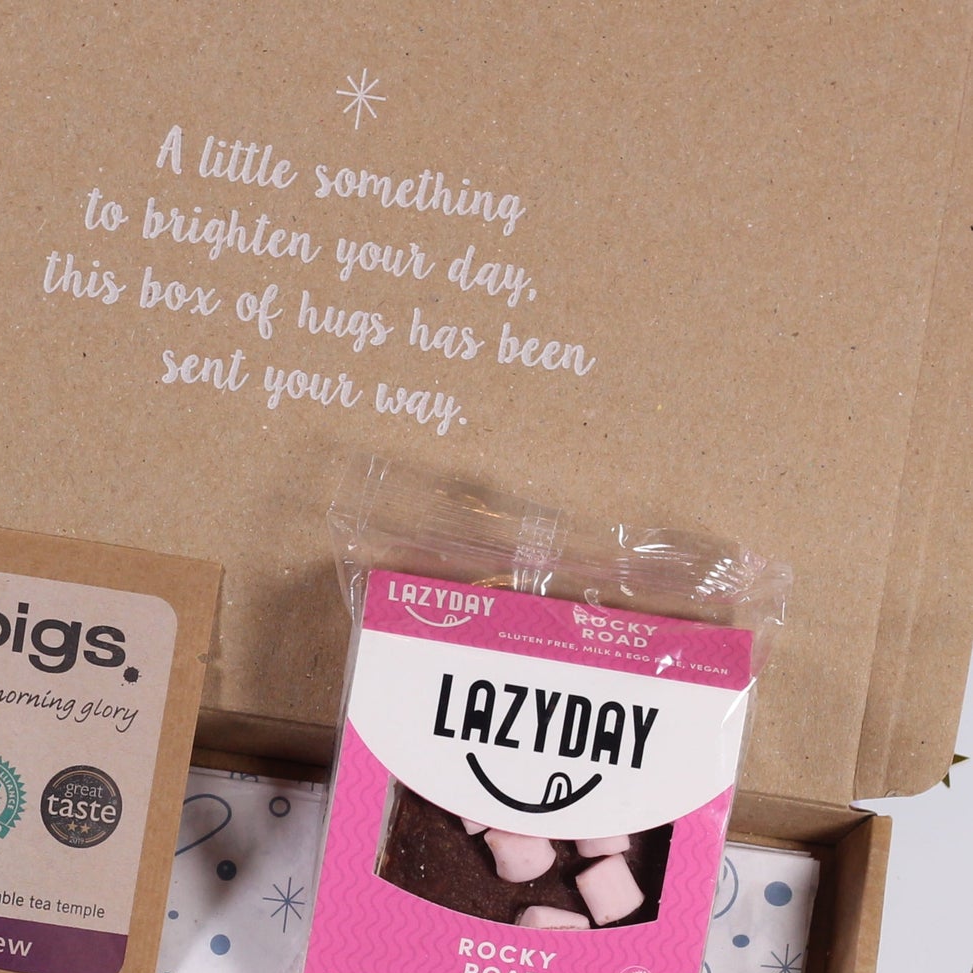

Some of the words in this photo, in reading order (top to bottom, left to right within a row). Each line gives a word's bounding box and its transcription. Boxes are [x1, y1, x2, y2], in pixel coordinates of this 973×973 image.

[156, 125, 182, 174] A
[199, 136, 298, 189] little
[315, 163, 525, 236] something
[85, 188, 127, 231] to
[143, 197, 321, 263] brighten
[336, 238, 435, 281] your
[448, 245, 537, 307] day,
[44, 250, 126, 304] this
[140, 266, 221, 315] box
[237, 284, 282, 340] of
[298, 291, 393, 352] hugs
[410, 308, 484, 360] has
[498, 323, 595, 375] been
[162, 349, 248, 391] sent
[264, 365, 362, 409] your
[376, 382, 467, 436] way.
[388, 581, 495, 616] LAZYDAY
[574, 613, 658, 636] ROCKY
[583, 629, 648, 648] ROAD
[498, 632, 544, 644] GLUTEN
[548, 639, 578, 651] FREE,
[583, 646, 611, 657] MILK
[626, 653, 650, 662] EGG
[690, 662, 728, 675] VEGAN
[75, 700, 138, 733] glory
[434, 673, 659, 769] LAZYDAY
[64, 783, 103, 798] great
[47, 794, 116, 823] taste
[29, 895, 51, 911] tea
[57, 898, 105, 920] temple
[458, 937, 557, 971] ROCKY
